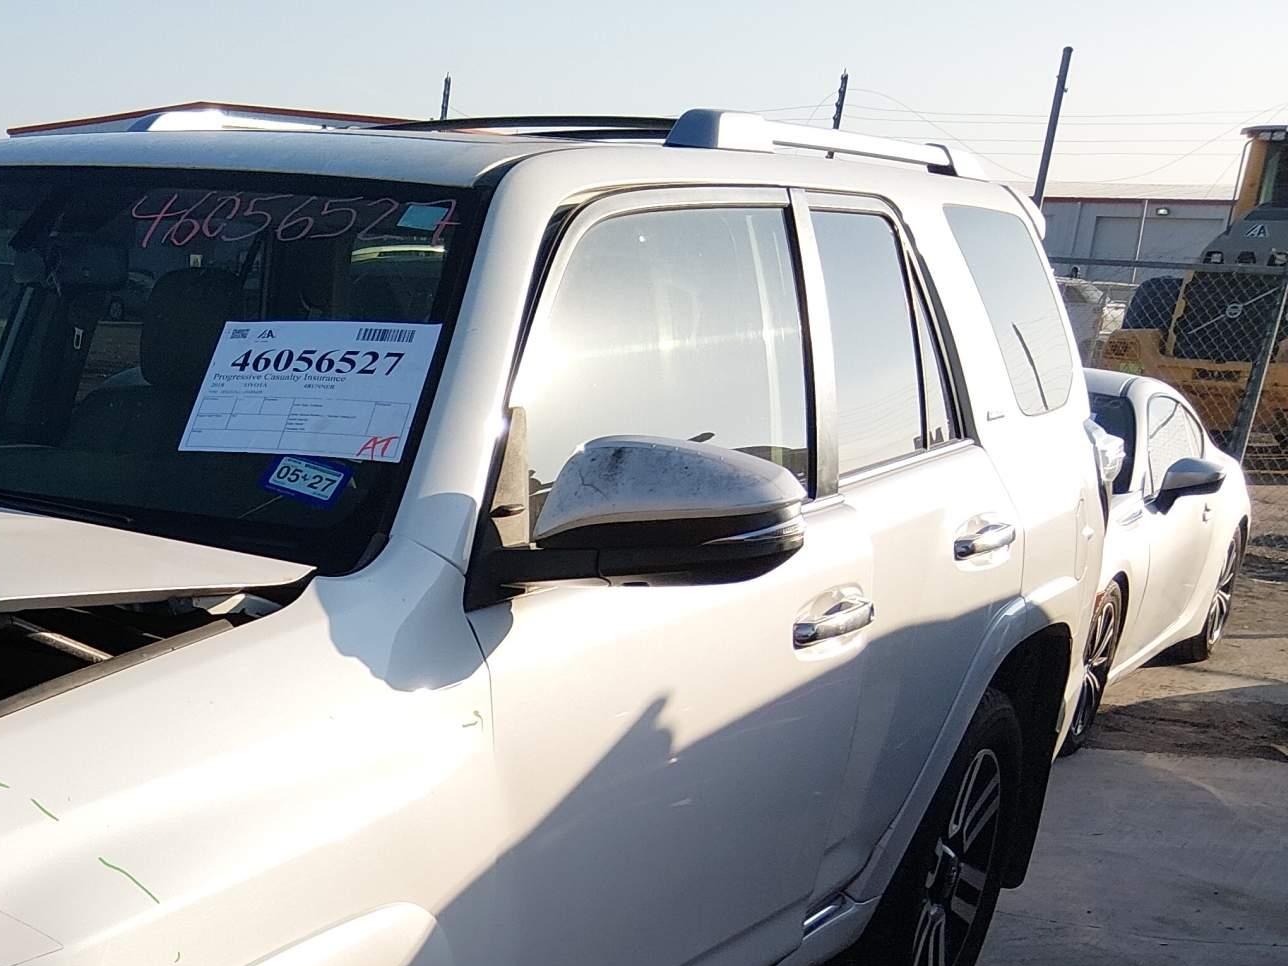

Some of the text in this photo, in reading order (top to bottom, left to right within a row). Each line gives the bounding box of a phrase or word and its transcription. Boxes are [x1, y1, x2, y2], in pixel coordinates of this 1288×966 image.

[132, 190, 461, 247] 46056527
[230, 349, 405, 376] 46056527
[213, 373, 347, 382] Progressive Casualty Insurance
